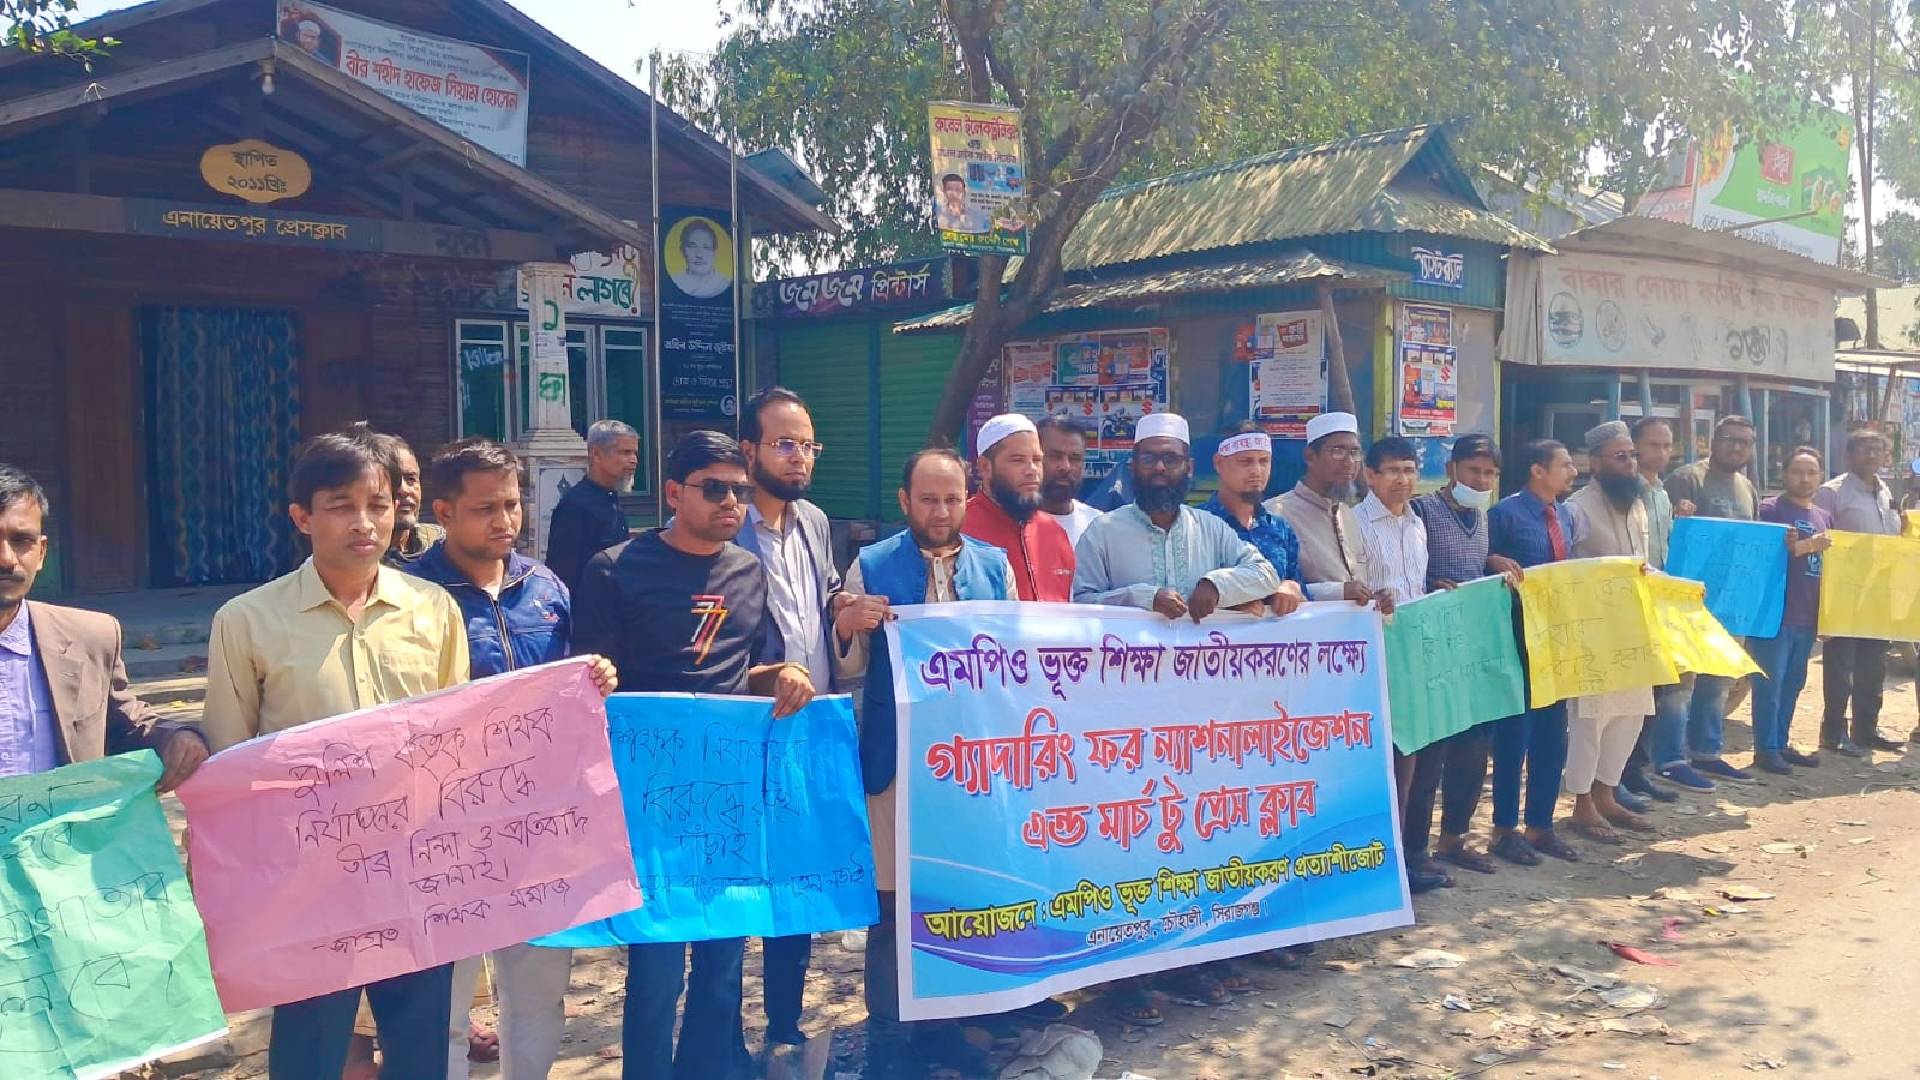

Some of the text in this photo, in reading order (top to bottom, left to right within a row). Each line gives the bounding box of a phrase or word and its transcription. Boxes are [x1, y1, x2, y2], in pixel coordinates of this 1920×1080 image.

[231, 150, 279, 168] স্থাপিত
[162, 210, 350, 241] এনায়েতপুর প্রেসক্লাব
[871, 263, 931, 302] প্রিন্টার্স
[921, 633, 1029, 692] এমপিও
[1037, 647, 1093, 701] ভূক্ত
[1100, 633, 1166, 684] শিক্ষা
[1173, 631, 1313, 681] জাতীয়করণের
[1316, 640, 1369, 674] লক্ষ্যে
[288, 742, 376, 807] পুলিশ
[925, 700, 1372, 794] গ্যাদারিং ফর ন্যাশনালাইজেশন
[1022, 775, 1318, 853] এন্ড মার্চ টু প্রেস ক্লাব
[409, 828, 460, 868] নিন্দা
[467, 826, 493, 850] ও
[1050, 878, 1113, 920] এমপিও
[1114, 877, 1153, 916] ভূক্ত
[1156, 866, 1200, 902] শিক্ষা
[1203, 855, 1291, 894] জাতীয়করণ
[1293, 839, 1387, 880] প্রত্যাশীজোট
